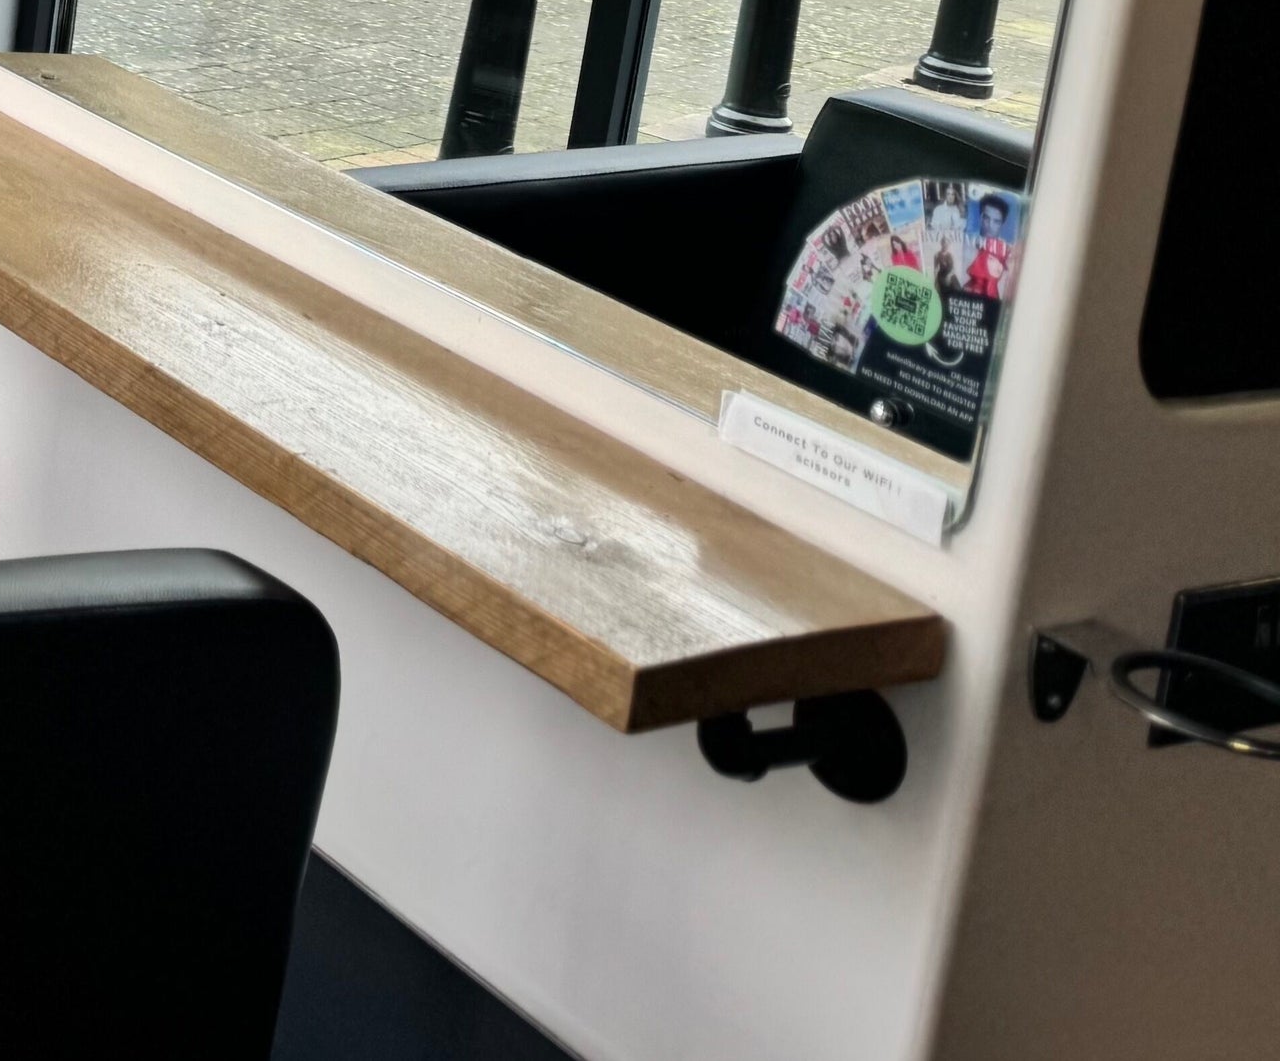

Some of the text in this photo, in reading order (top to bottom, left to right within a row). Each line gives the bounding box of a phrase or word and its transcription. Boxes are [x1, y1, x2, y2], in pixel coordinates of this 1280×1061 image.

[949, 297, 970, 308] SCAN
[949, 306, 960, 315] TO
[861, 366, 873, 378] NO
[874, 372, 893, 386] NEED
[894, 380, 904, 391] TO
[904, 386, 946, 410] DOWNLOAD
[899, 370, 911, 381] NO
[912, 376, 931, 390] NEED
[933, 384, 942, 395] TO
[753, 416, 807, 449] Connect
[813, 441, 829, 459] To
[833, 454, 857, 473] Our
[795, 454, 851, 487] scissors
